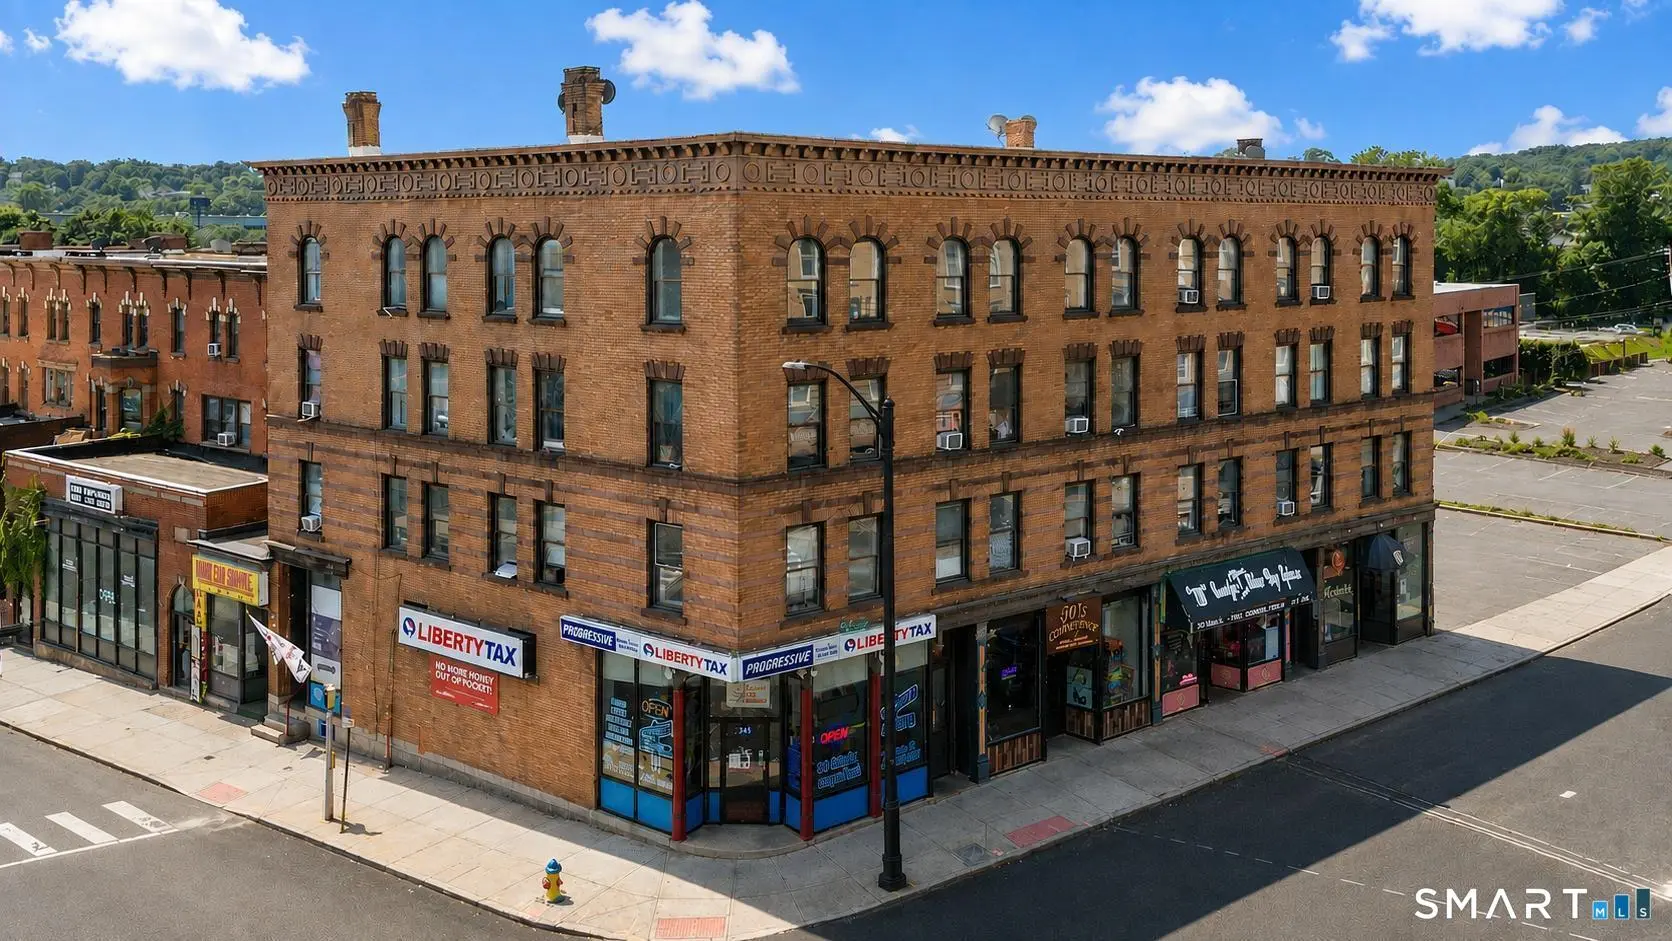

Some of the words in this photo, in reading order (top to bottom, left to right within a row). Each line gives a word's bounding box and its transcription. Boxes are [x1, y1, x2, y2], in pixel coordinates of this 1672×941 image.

[563, 623, 614, 647] PROGRESSIVE
[745, 650, 811, 675] PROGRESSIVE
[435, 670, 450, 682] OUT
[641, 699, 669, 718] OPEN
[821, 727, 849, 744] OPEN
